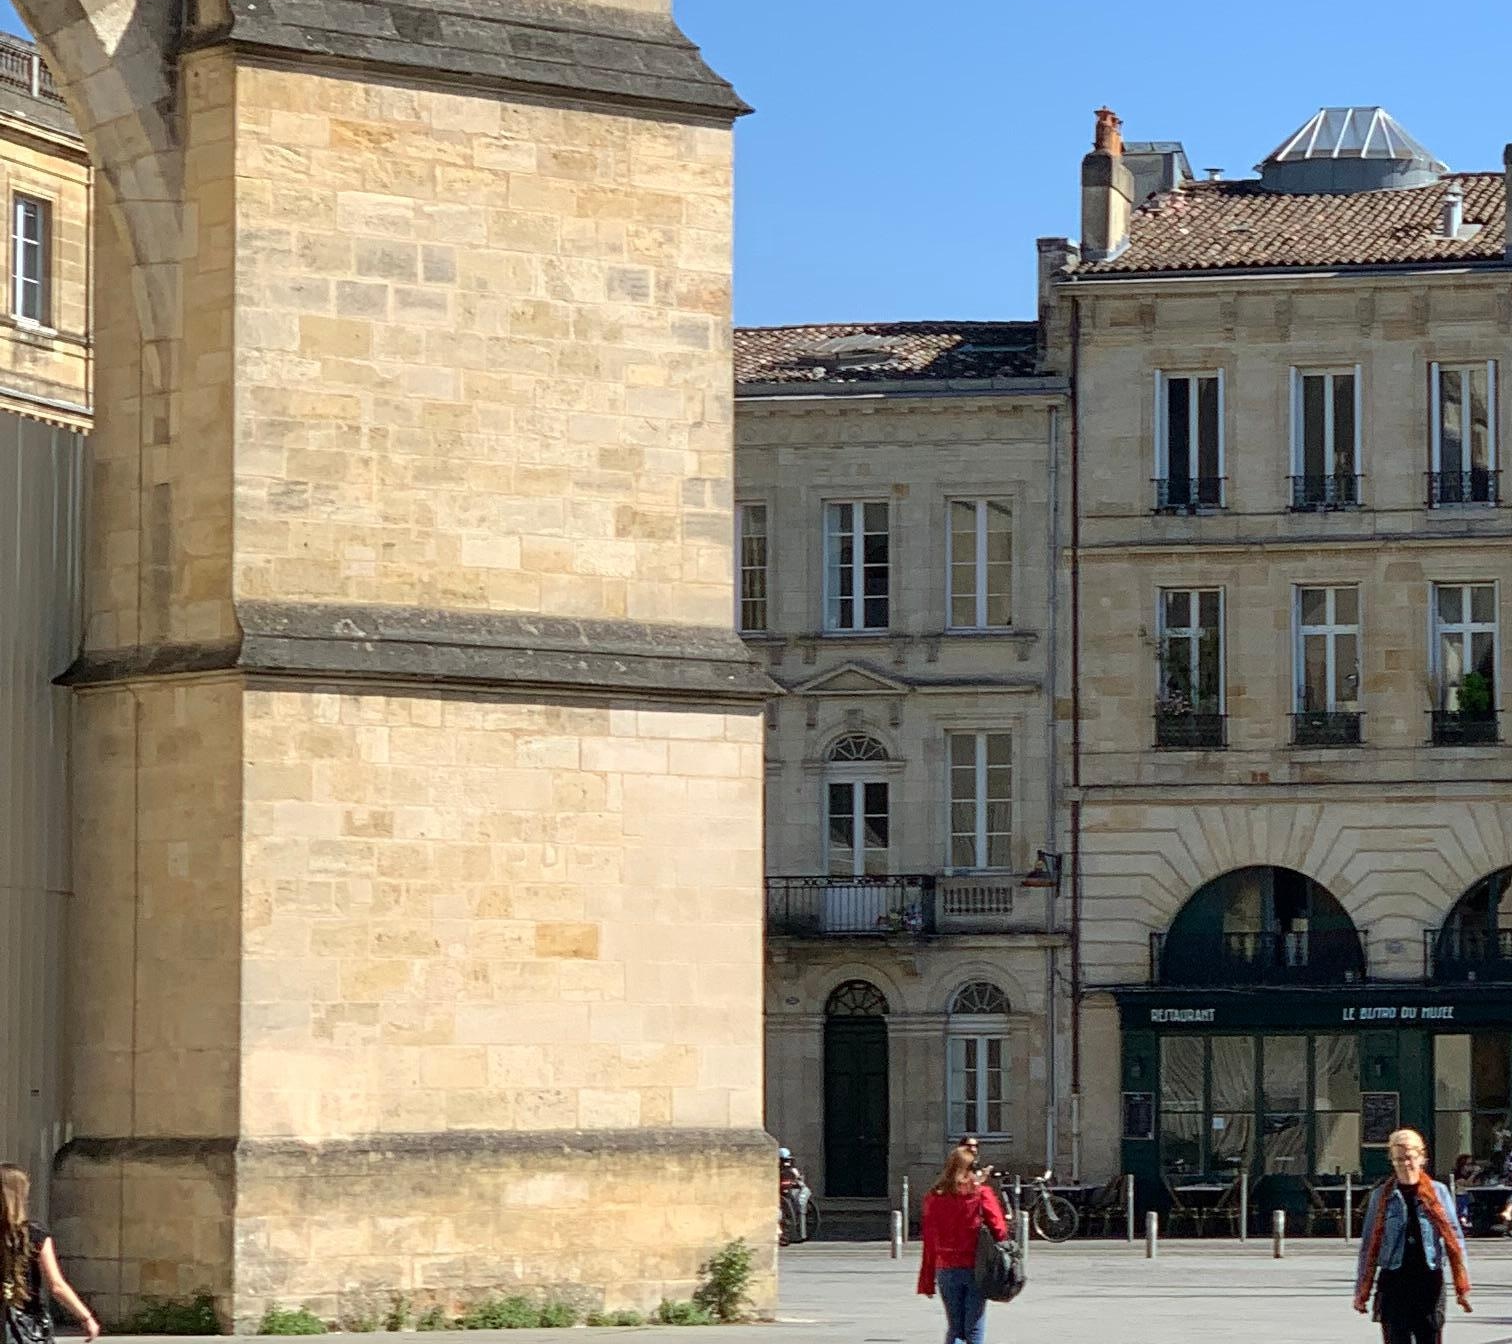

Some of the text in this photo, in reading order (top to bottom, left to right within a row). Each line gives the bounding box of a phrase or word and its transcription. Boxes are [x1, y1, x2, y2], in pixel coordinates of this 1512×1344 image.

[1151, 1008, 1215, 1022] RESTAURANT
[1342, 1007, 1355, 1020] LE
[1359, 1007, 1397, 1020] BISTRO
[1400, 1006, 1417, 1019] DU
